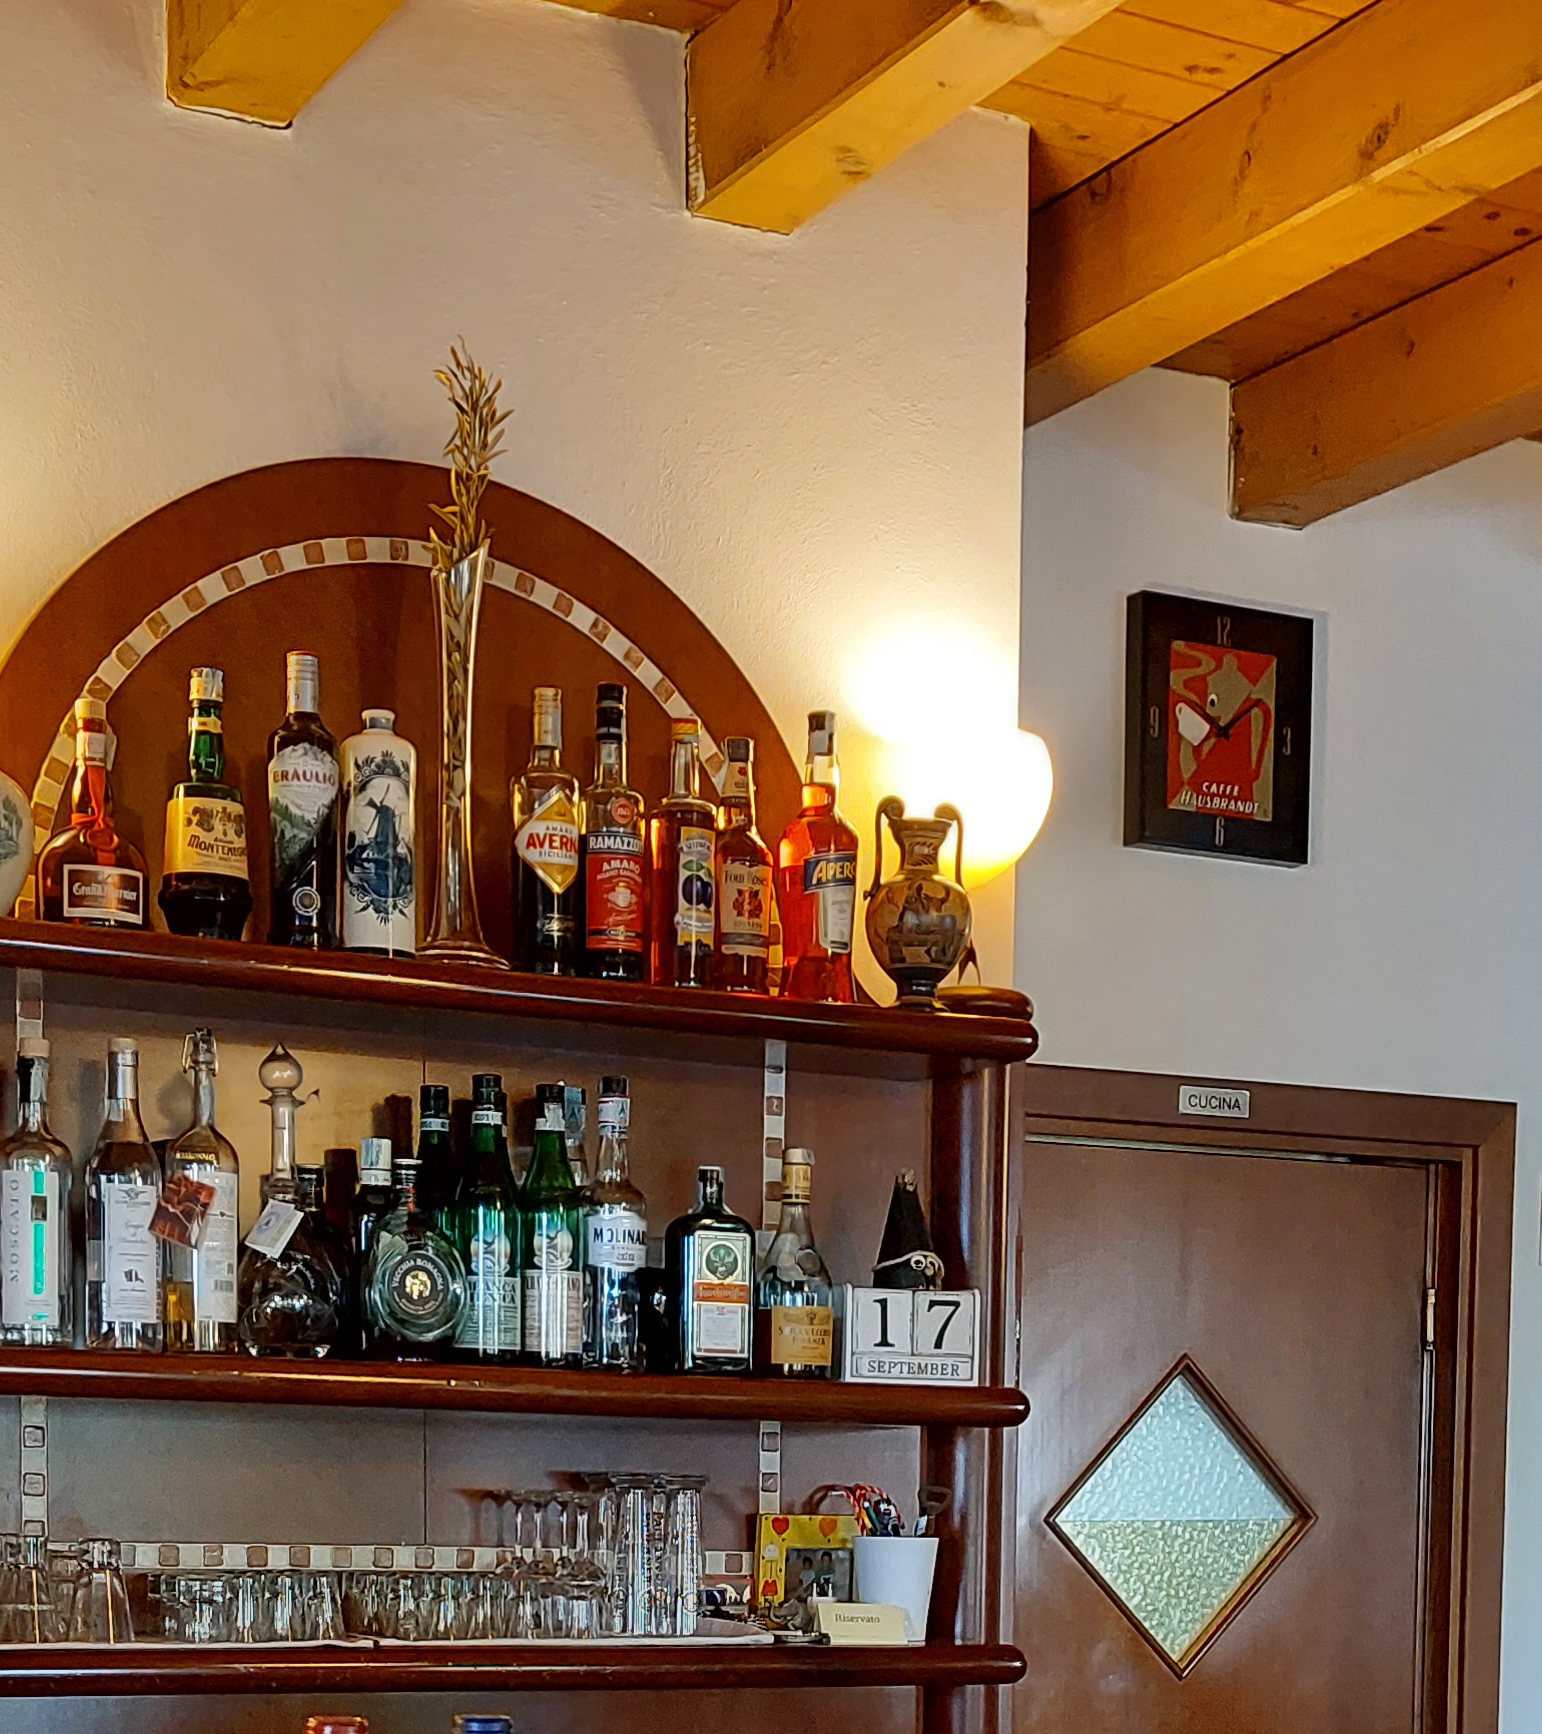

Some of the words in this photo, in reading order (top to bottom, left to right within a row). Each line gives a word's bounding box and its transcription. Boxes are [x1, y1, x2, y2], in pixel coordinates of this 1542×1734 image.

[1216, 616, 1232, 647] 12
[1149, 705, 1160, 738] 9
[1282, 726, 1292, 756] 3
[1180, 790, 1260, 815] HAUSBRANDT
[1214, 816, 1225, 847] 6
[601, 858, 641, 875] AMARO
[1187, 1093, 1242, 1112] CUCINA
[9, 1178, 20, 1284] MOSCATO
[867, 1359, 961, 1377] SEPTEMBER
[834, 1613, 881, 1624] Riservato
